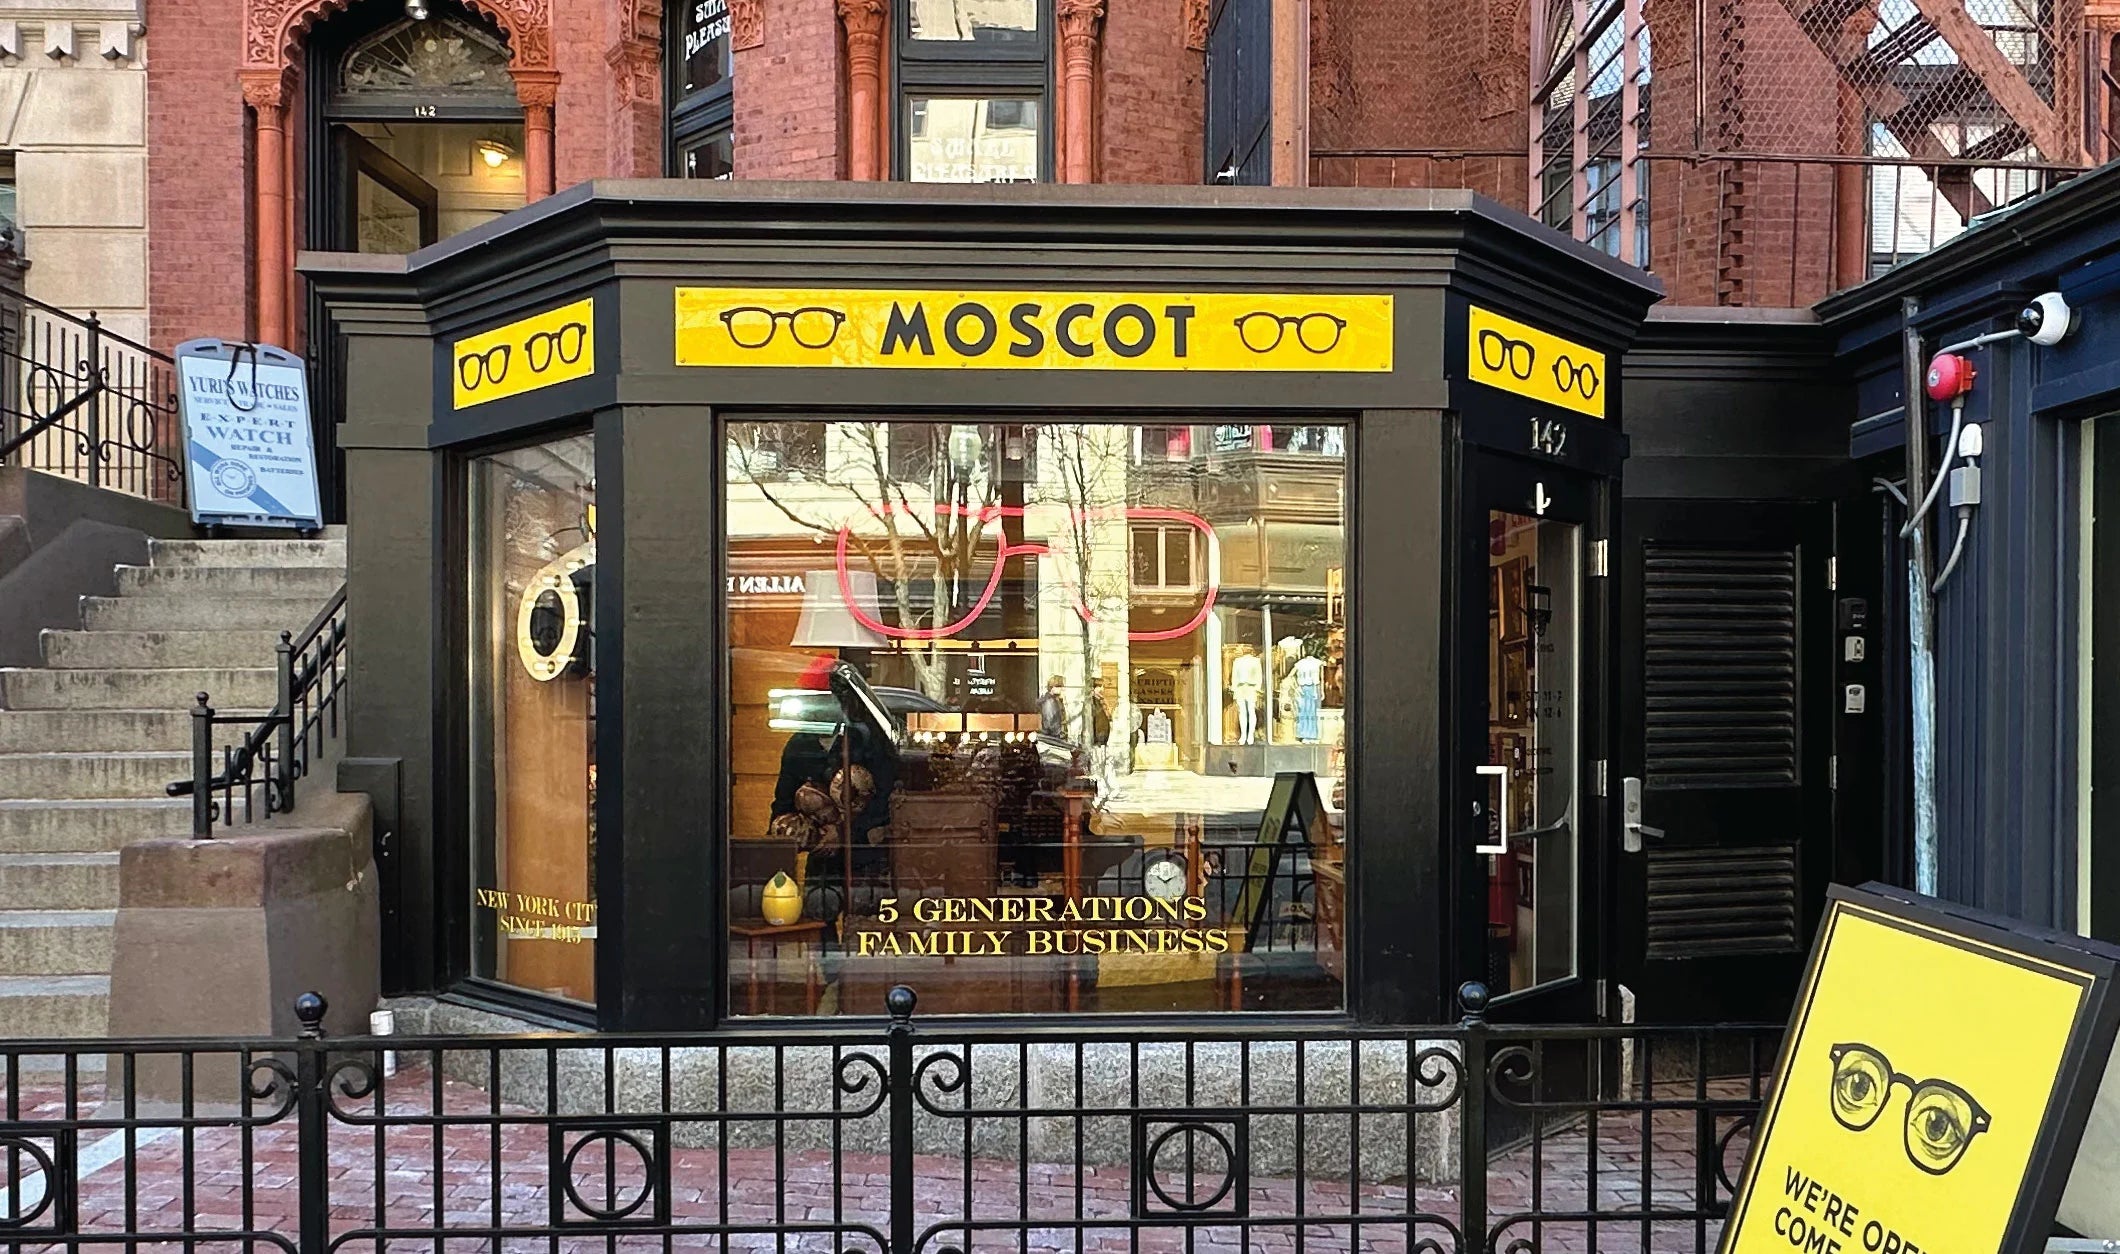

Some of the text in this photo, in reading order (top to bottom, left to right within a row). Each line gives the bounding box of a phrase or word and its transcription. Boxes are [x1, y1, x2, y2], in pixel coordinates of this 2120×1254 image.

[414, 105, 436, 117] 142
[880, 301, 1195, 358] MOSCOT
[189, 376, 235, 396] YURI'S
[238, 399, 265, 410] TRAE
[207, 426, 292, 445] WATCH
[1529, 416, 1567, 456] 142
[477, 888, 597, 922] NEW YORK CIT
[877, 897, 1207, 923] 5 GENERATIONS
[500, 915, 545, 937] SINCE
[856, 928, 1230, 957] FAMILY BUSINESS
[1785, 1165, 1928, 1254] WE'RE OP
